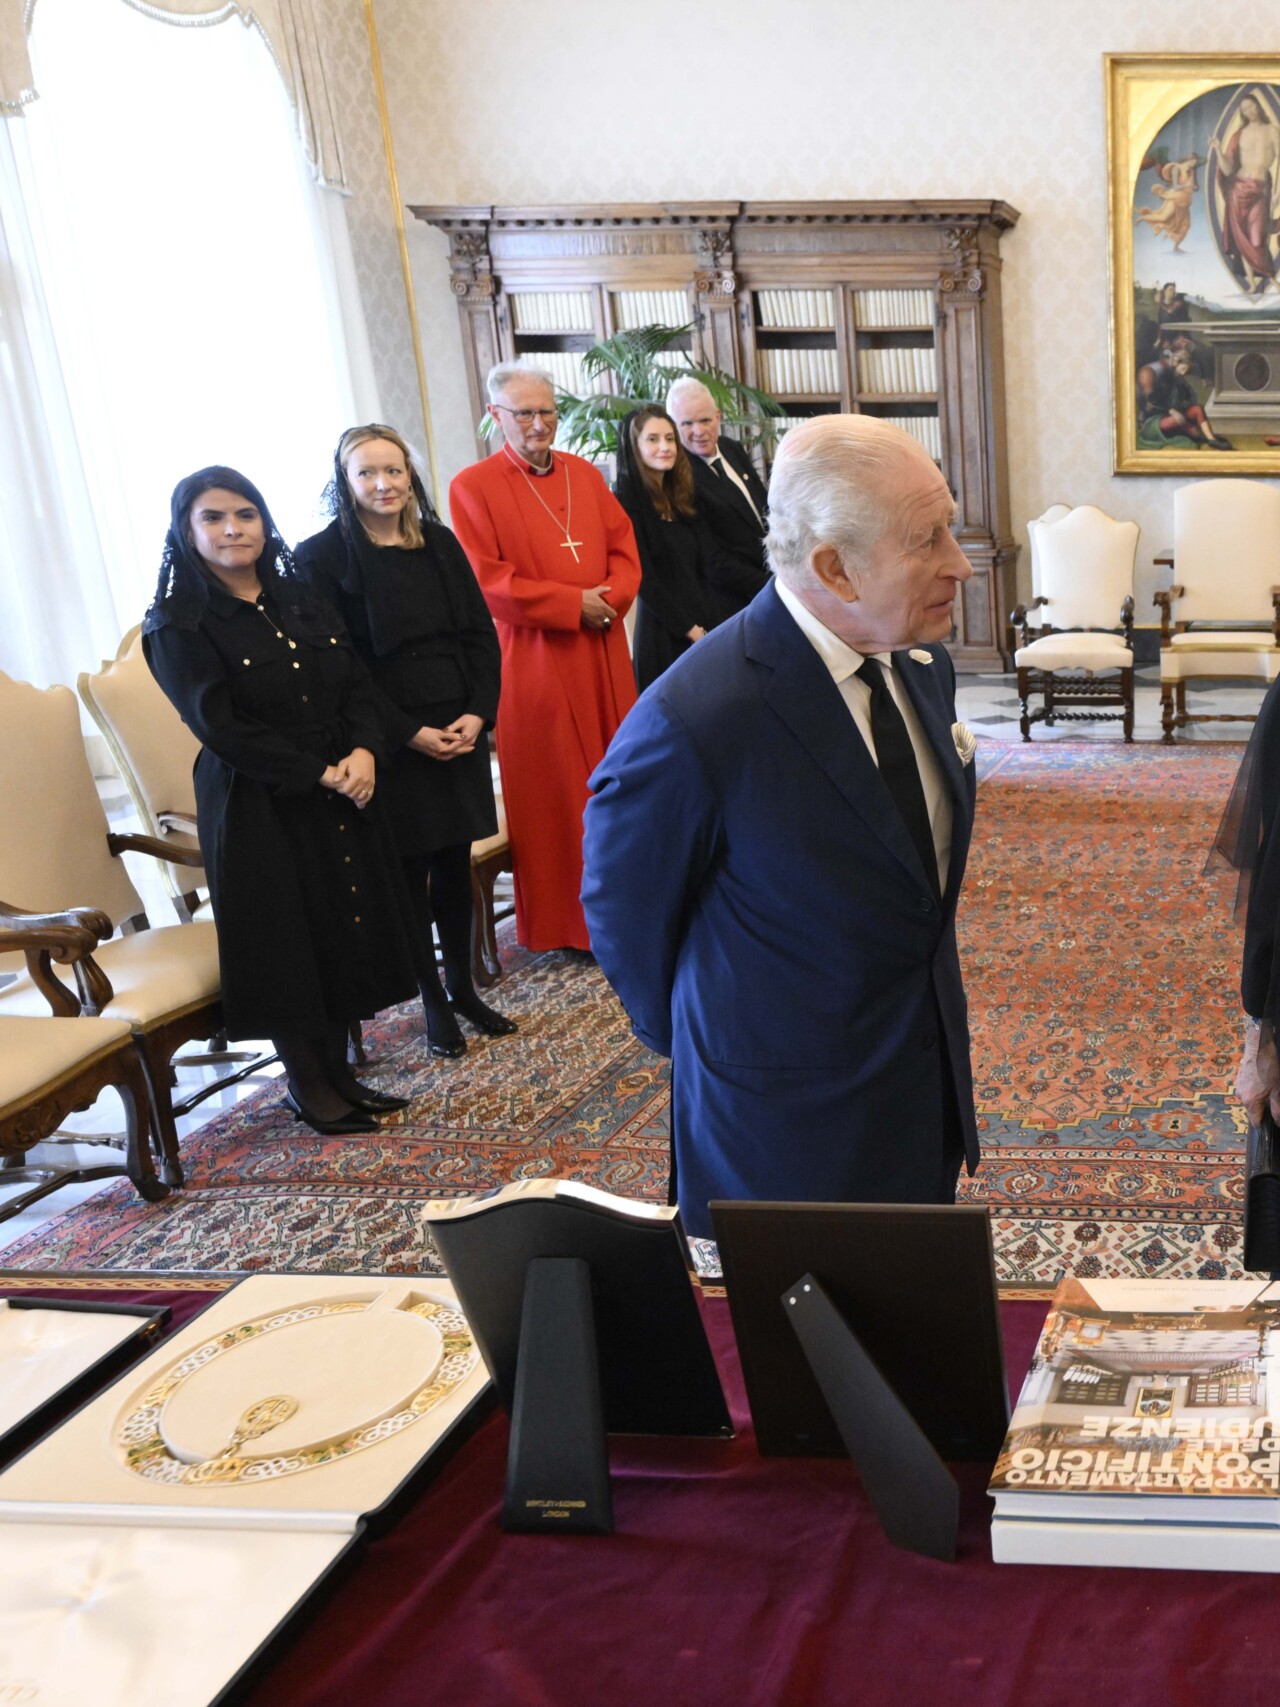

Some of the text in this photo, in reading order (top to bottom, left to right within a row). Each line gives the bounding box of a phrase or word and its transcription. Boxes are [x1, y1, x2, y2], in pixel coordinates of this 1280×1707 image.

[1187, 1439, 1280, 1452] DELLE
[1012, 1449, 1280, 1474] PONTIFICIO
[1006, 1470, 1279, 1487] L'APPARTAMENTO
